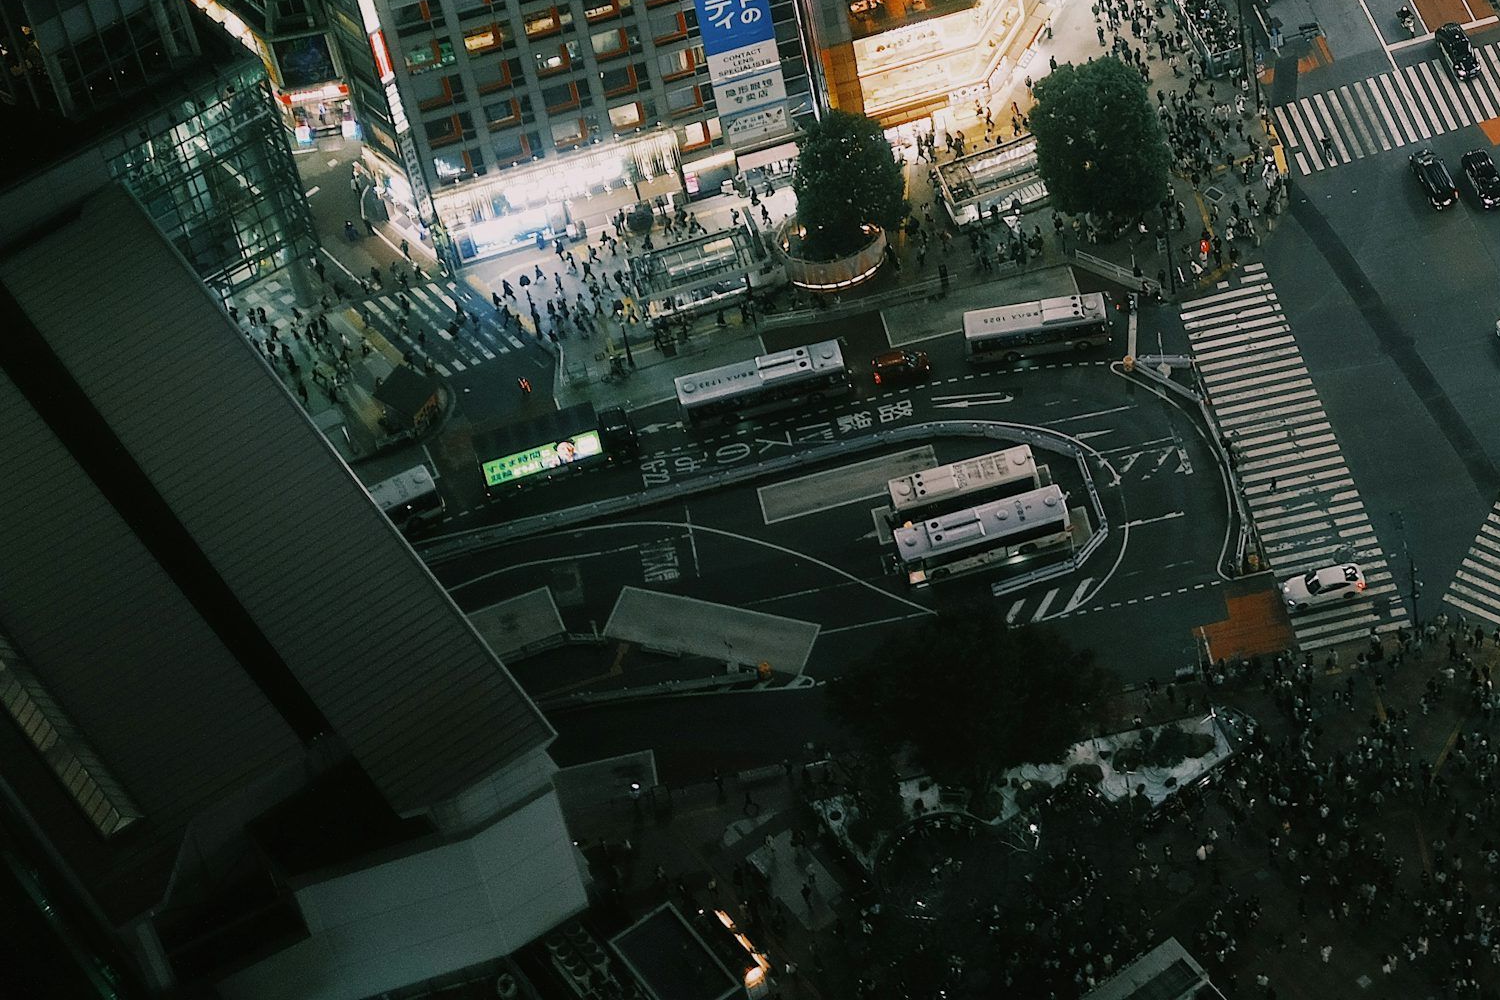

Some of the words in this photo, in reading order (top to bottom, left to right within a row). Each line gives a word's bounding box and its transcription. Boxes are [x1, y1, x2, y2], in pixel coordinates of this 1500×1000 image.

[723, 48, 761, 62] CONTACT
[734, 57, 754, 67] LENS
[718, 58, 773, 77] SPECIALISTS
